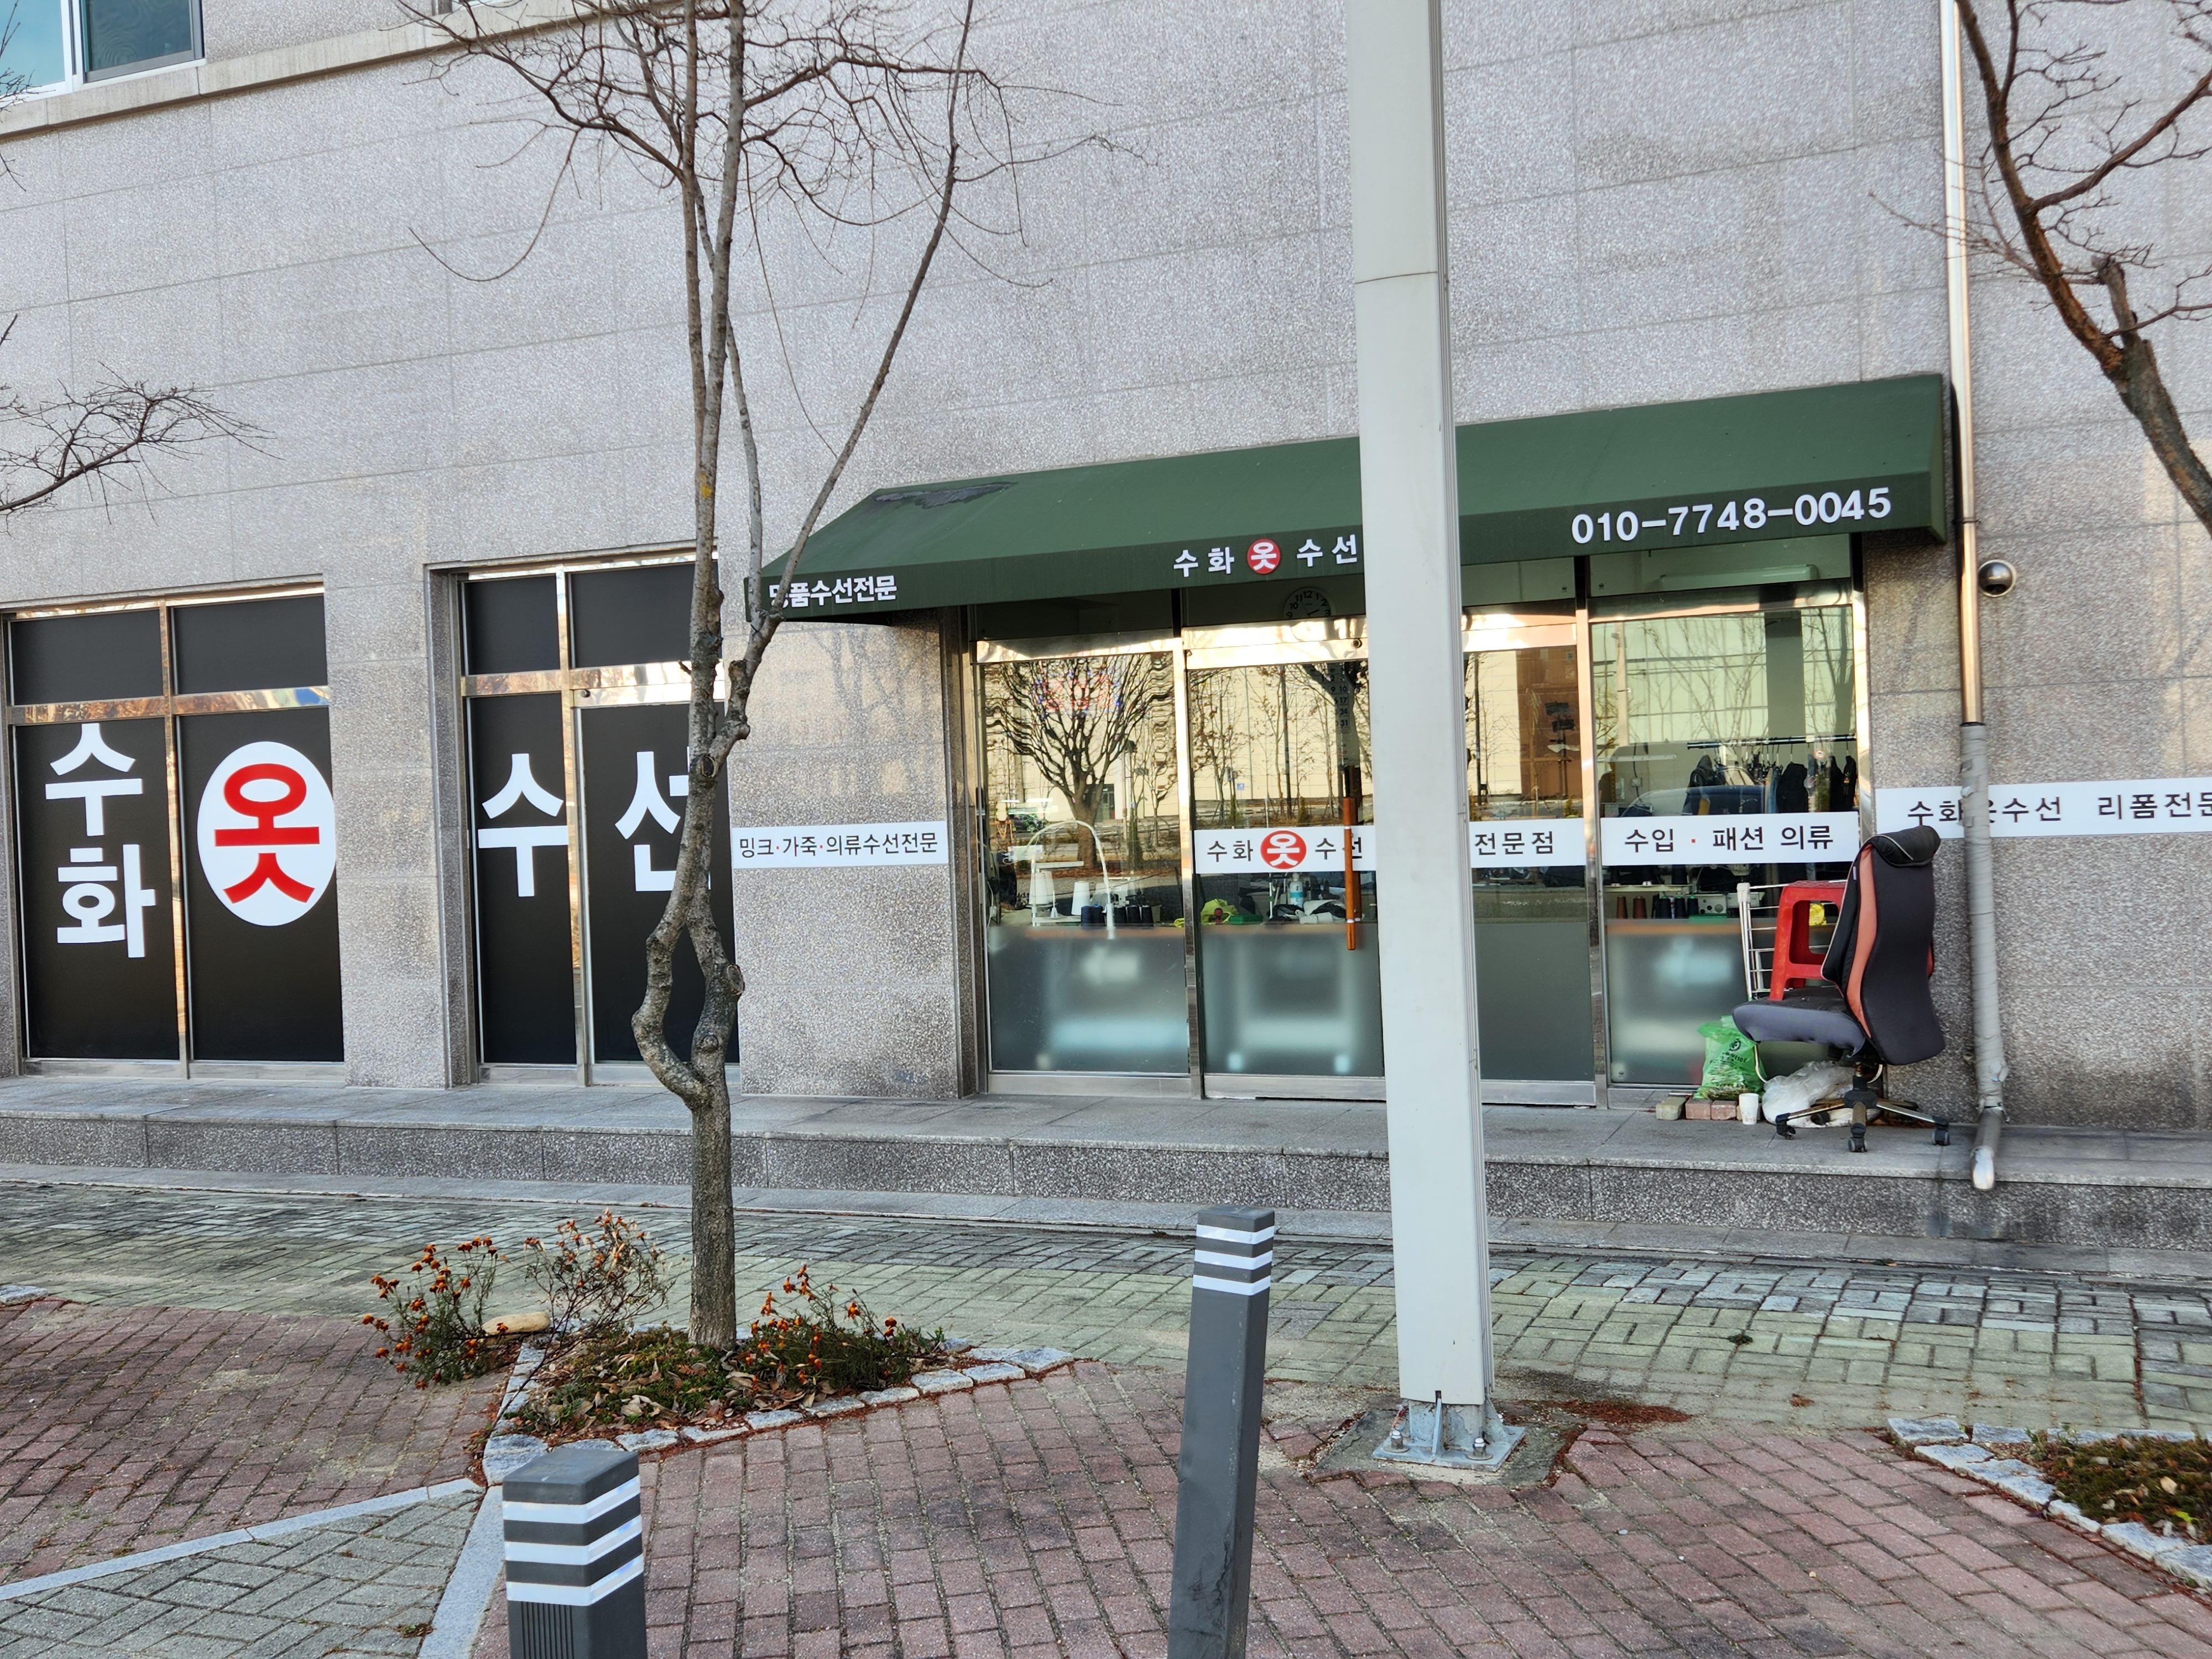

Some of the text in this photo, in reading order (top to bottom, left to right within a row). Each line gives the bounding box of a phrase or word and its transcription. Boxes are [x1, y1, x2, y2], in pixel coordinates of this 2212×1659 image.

[1572, 487, 1891, 544] 010-7748-0045
[1173, 534, 1358, 577] 수화 옷 수선
[1908, 796, 2062, 826] 수화수선
[45, 723, 155, 958] 수화
[214, 763, 320, 904] 옷
[1207, 839, 1253, 862] 수화
[1267, 833, 1300, 867] 옷
[1474, 831, 1554, 856] 전문점
[1625, 825, 1834, 853] 수입 패션 의류
